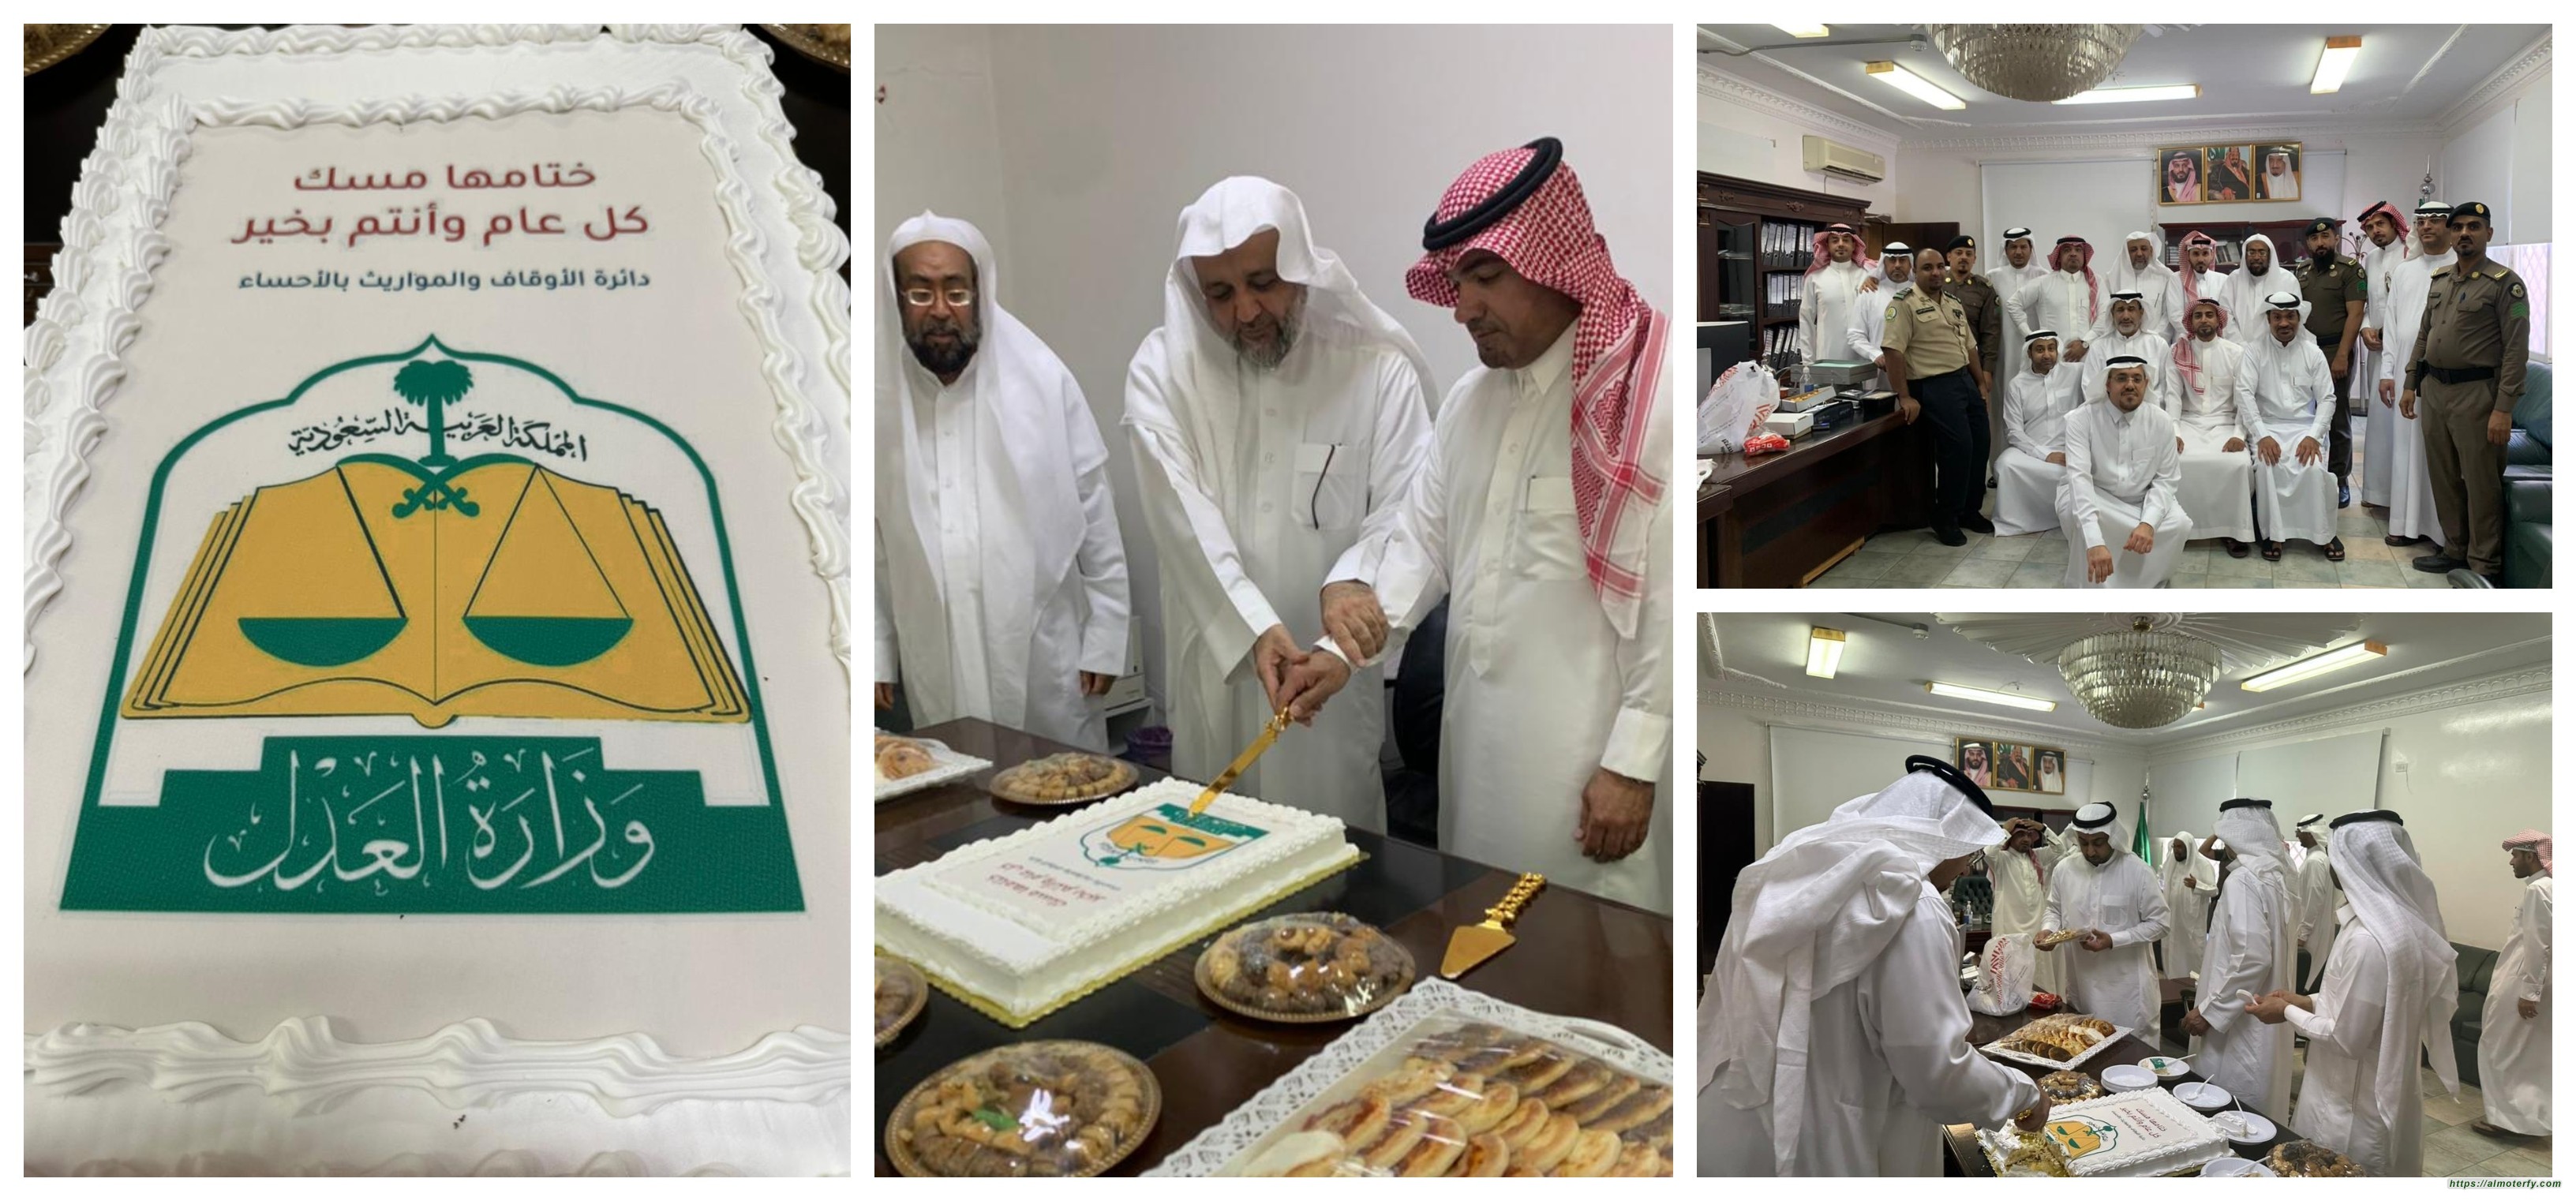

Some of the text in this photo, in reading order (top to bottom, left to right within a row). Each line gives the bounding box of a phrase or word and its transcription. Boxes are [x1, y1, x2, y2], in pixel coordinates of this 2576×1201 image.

[294, 163, 597, 191] ختامها مسك
[230, 201, 650, 248] كل عام وأنتم بخير
[239, 268, 650, 293] دائرة الأوقاف والمواريث بالأحساء
